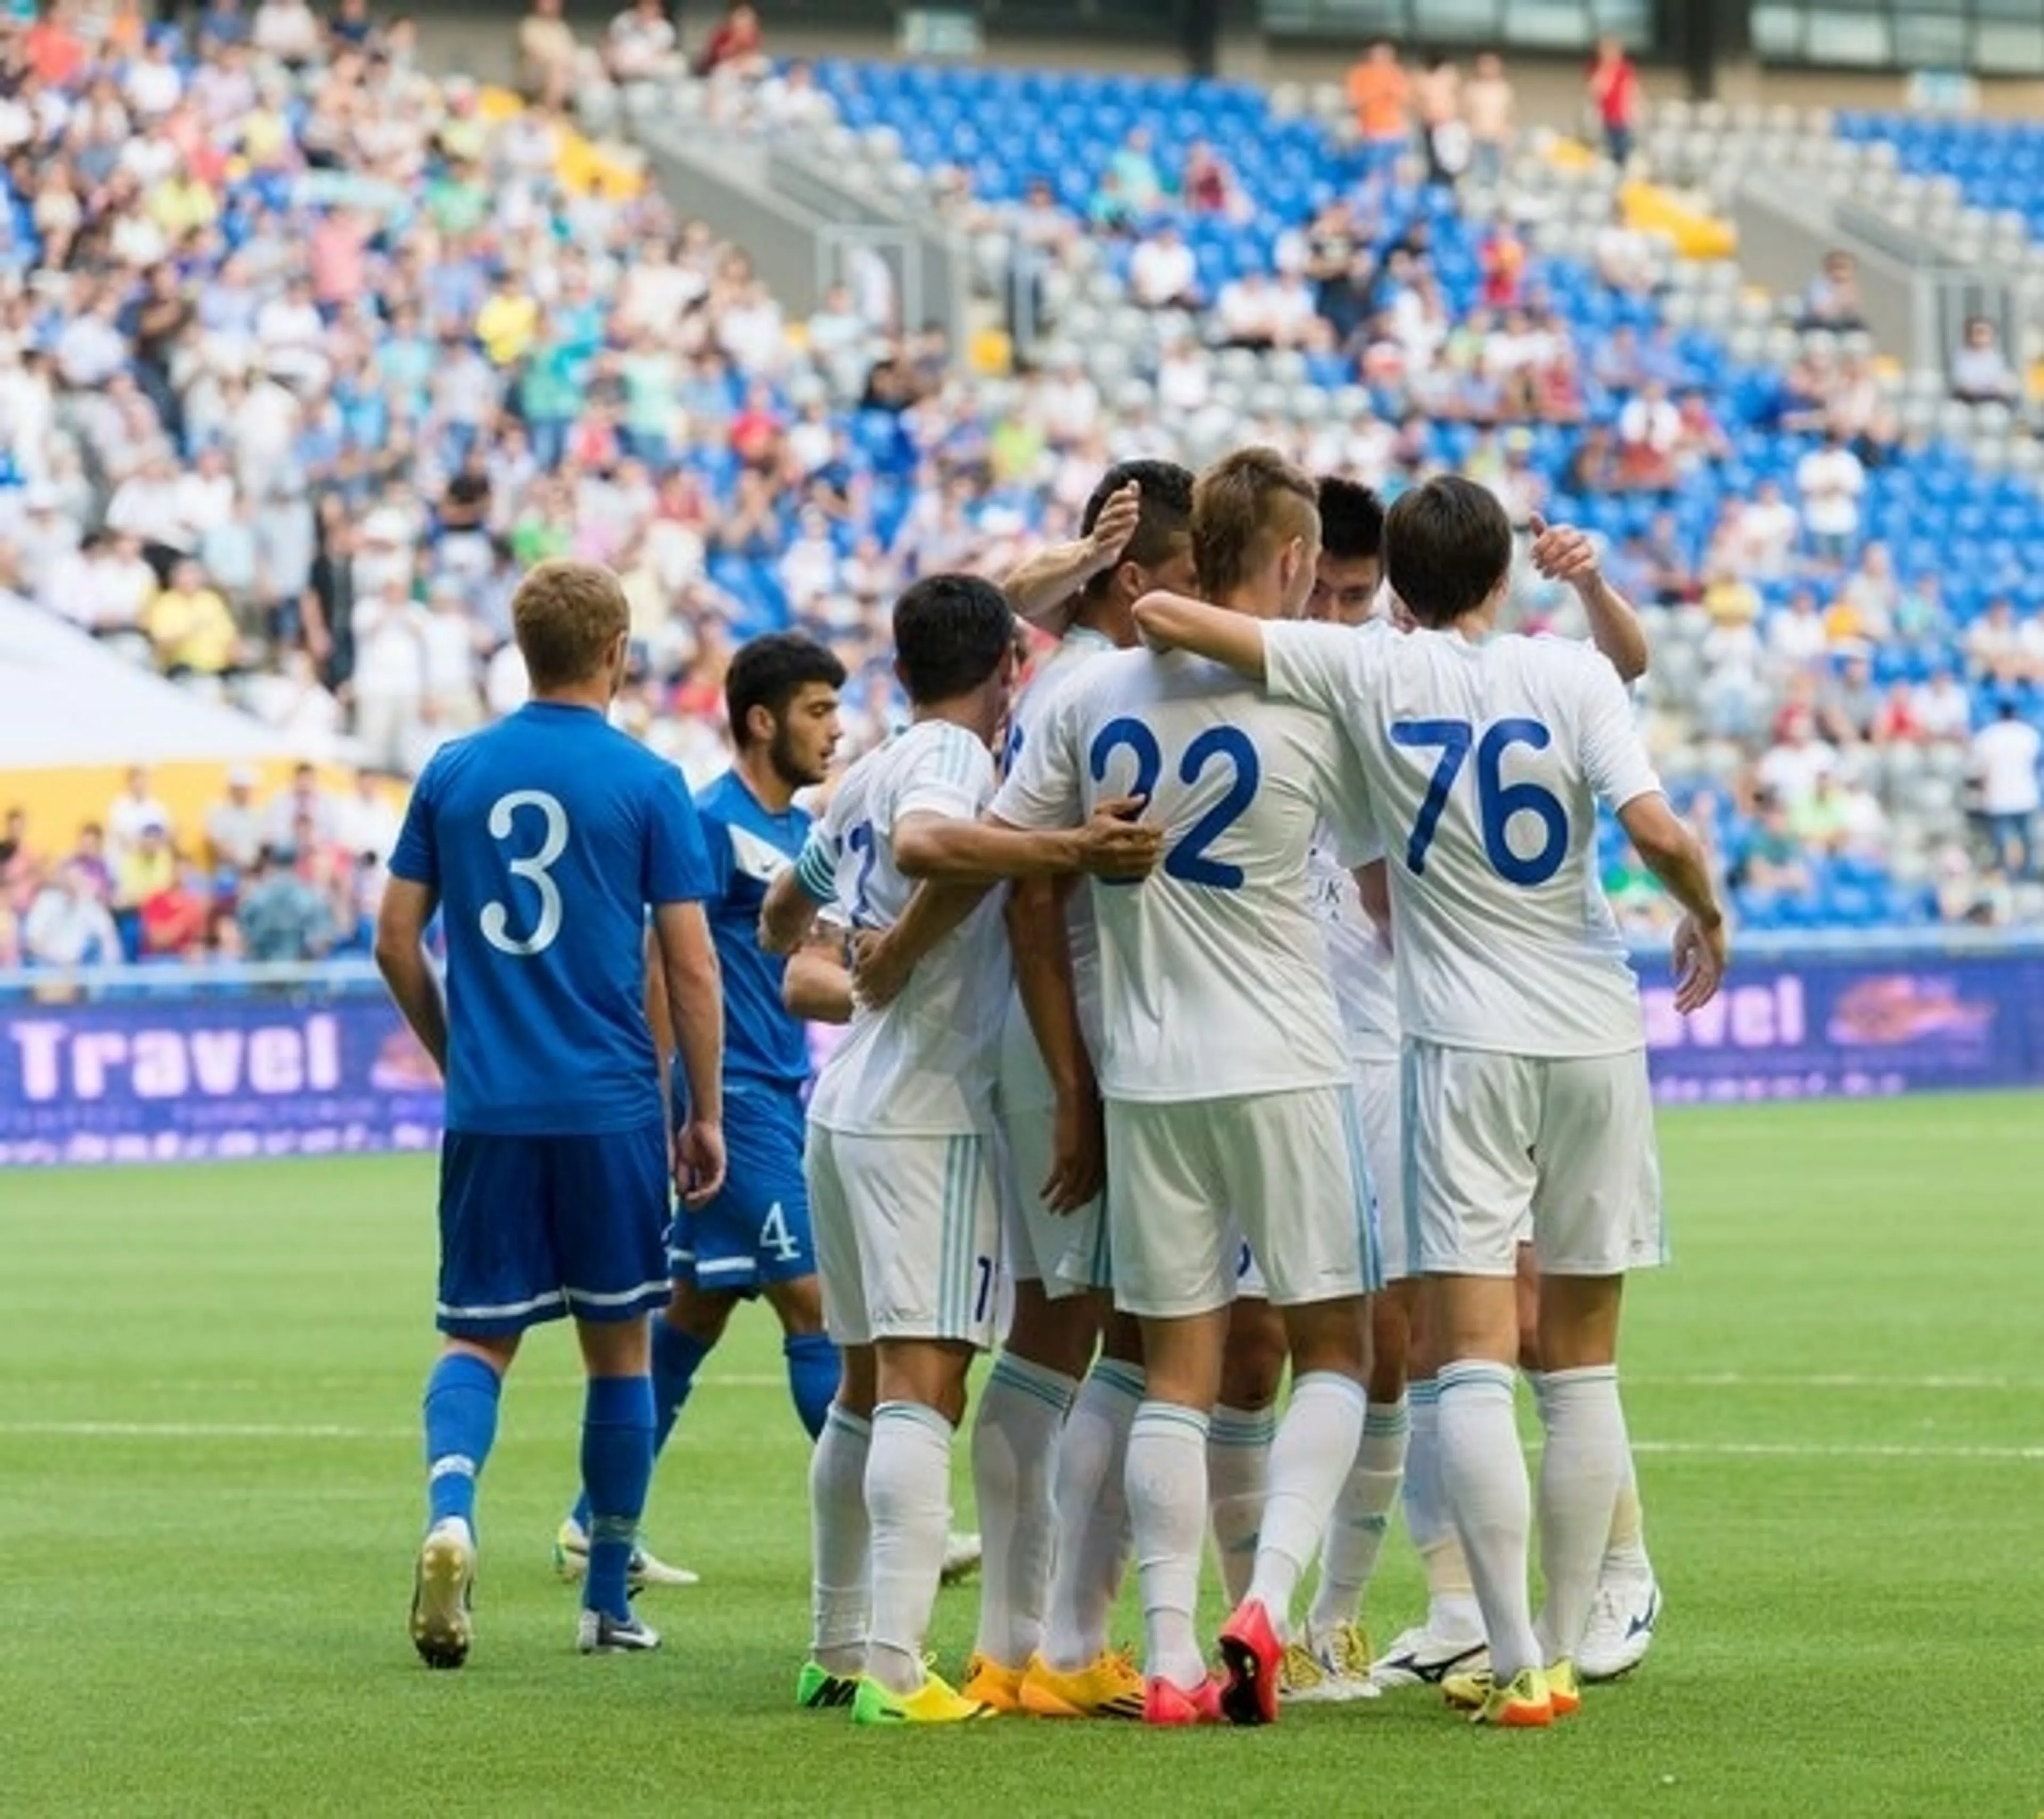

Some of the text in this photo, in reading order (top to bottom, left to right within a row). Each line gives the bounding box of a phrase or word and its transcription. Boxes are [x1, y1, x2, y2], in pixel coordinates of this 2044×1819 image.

[480, 790, 568, 955] 3
[1090, 717, 1259, 890] 22
[1390, 718, 1569, 887] 76
[10, 1013, 339, 1101] Travel
[760, 1201, 801, 1261] 4
